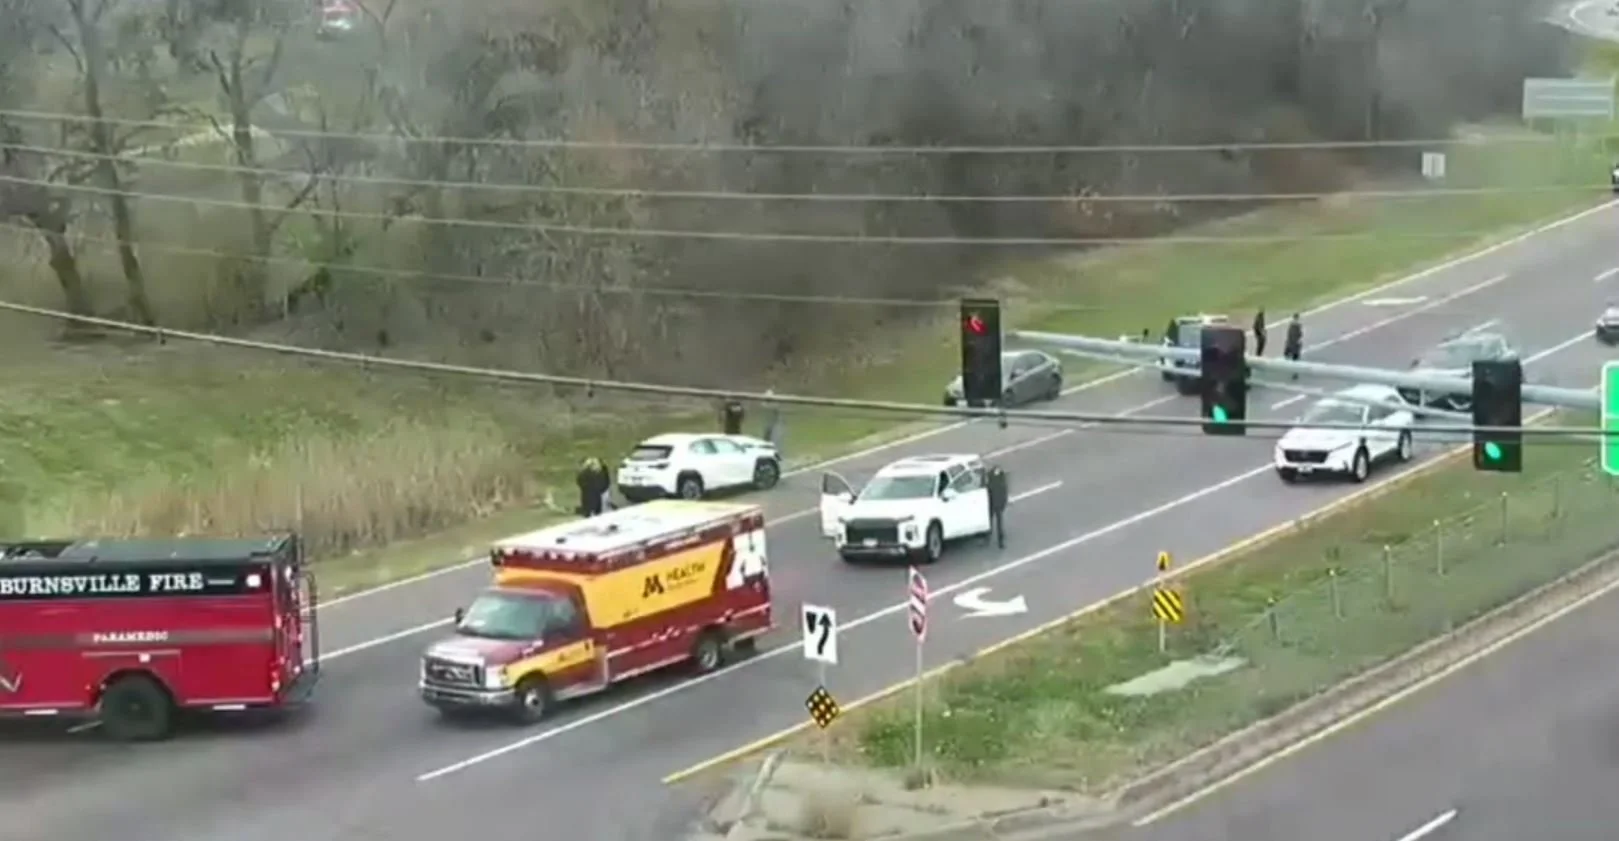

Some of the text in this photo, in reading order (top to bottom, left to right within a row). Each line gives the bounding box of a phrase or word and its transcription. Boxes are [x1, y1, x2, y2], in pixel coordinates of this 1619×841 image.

[0, 573, 204, 594] BURNSVILLE FIRE
[642, 574, 664, 598] M
[666, 562, 705, 580] HEALTH
[93, 631, 168, 642] PARAMEDIC
